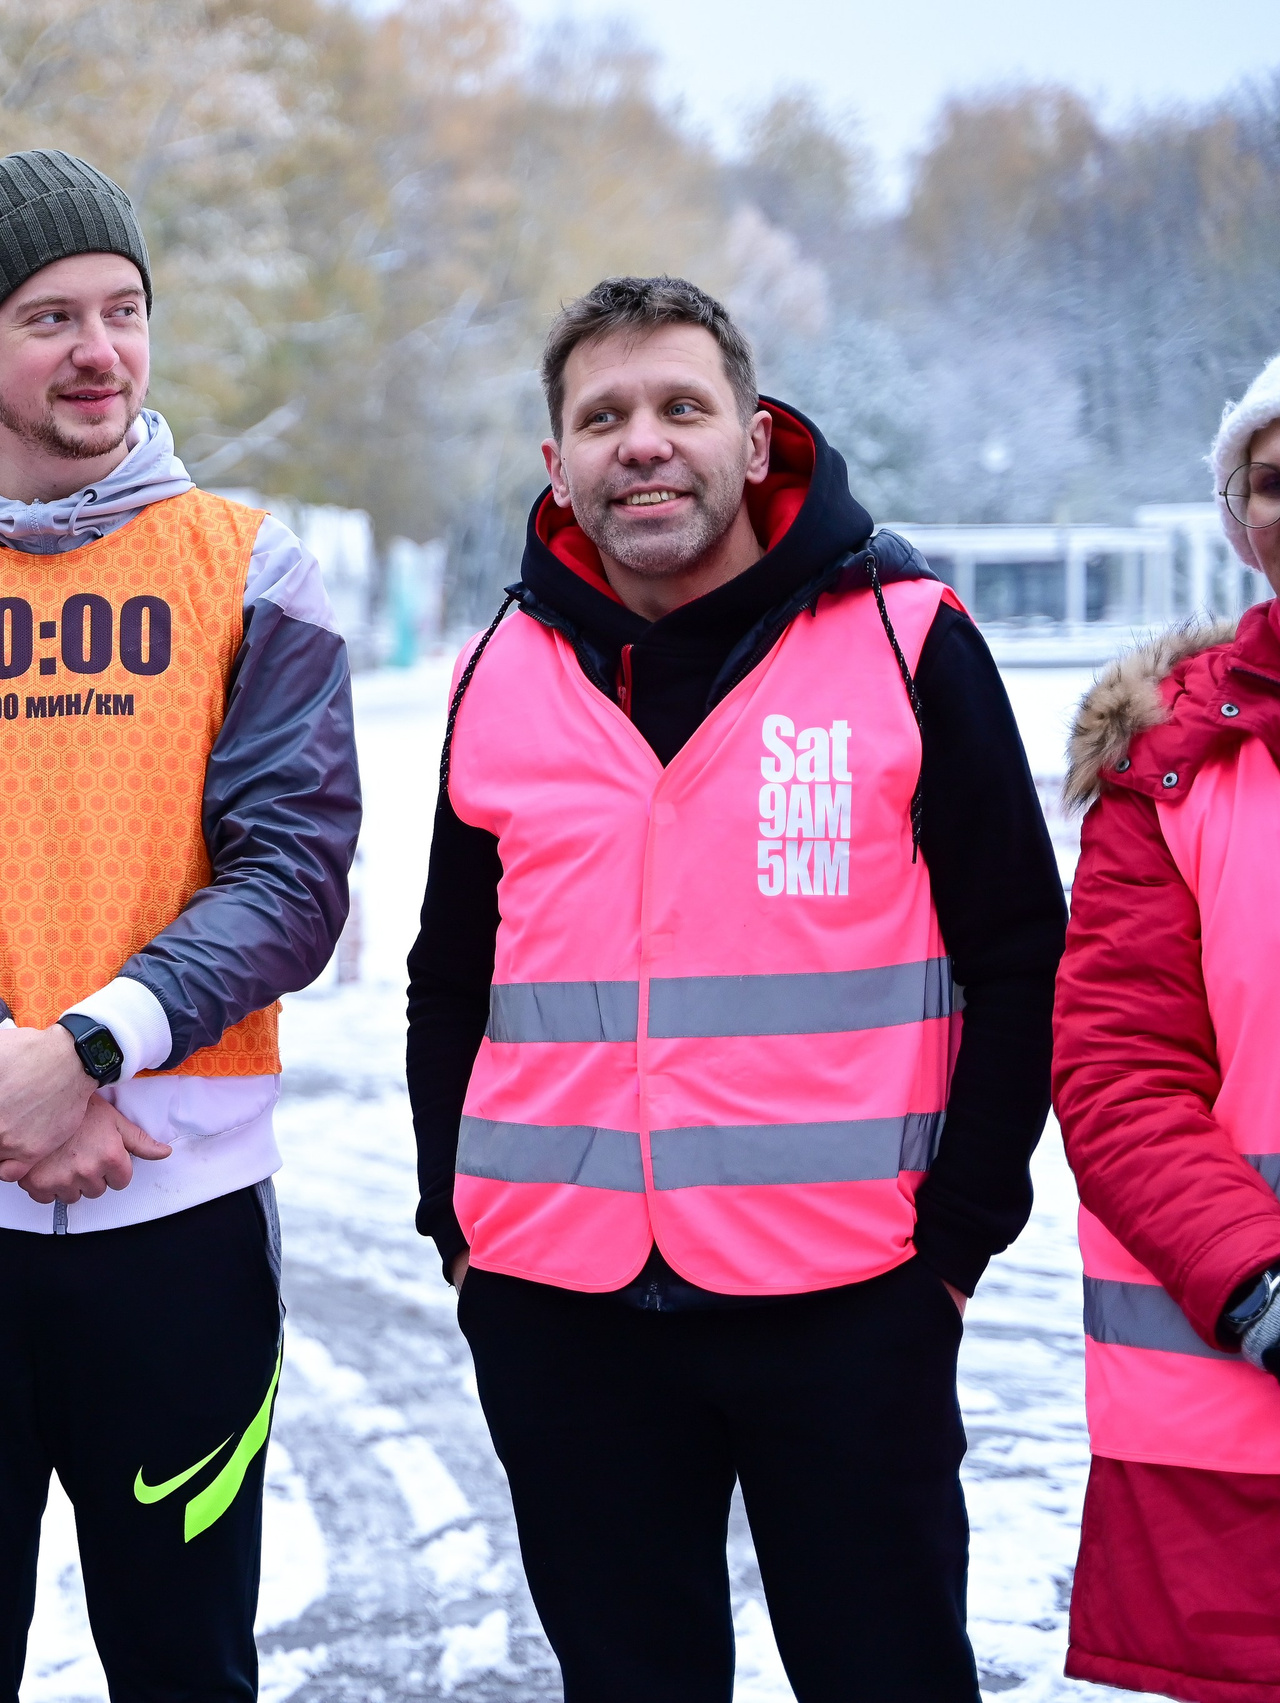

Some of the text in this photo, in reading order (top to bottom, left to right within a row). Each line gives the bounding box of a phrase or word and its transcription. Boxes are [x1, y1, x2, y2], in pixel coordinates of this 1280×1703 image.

[760, 713, 853, 783] Sat
[758, 783, 852, 839] 9AM
[757, 839, 850, 897] 5KM
